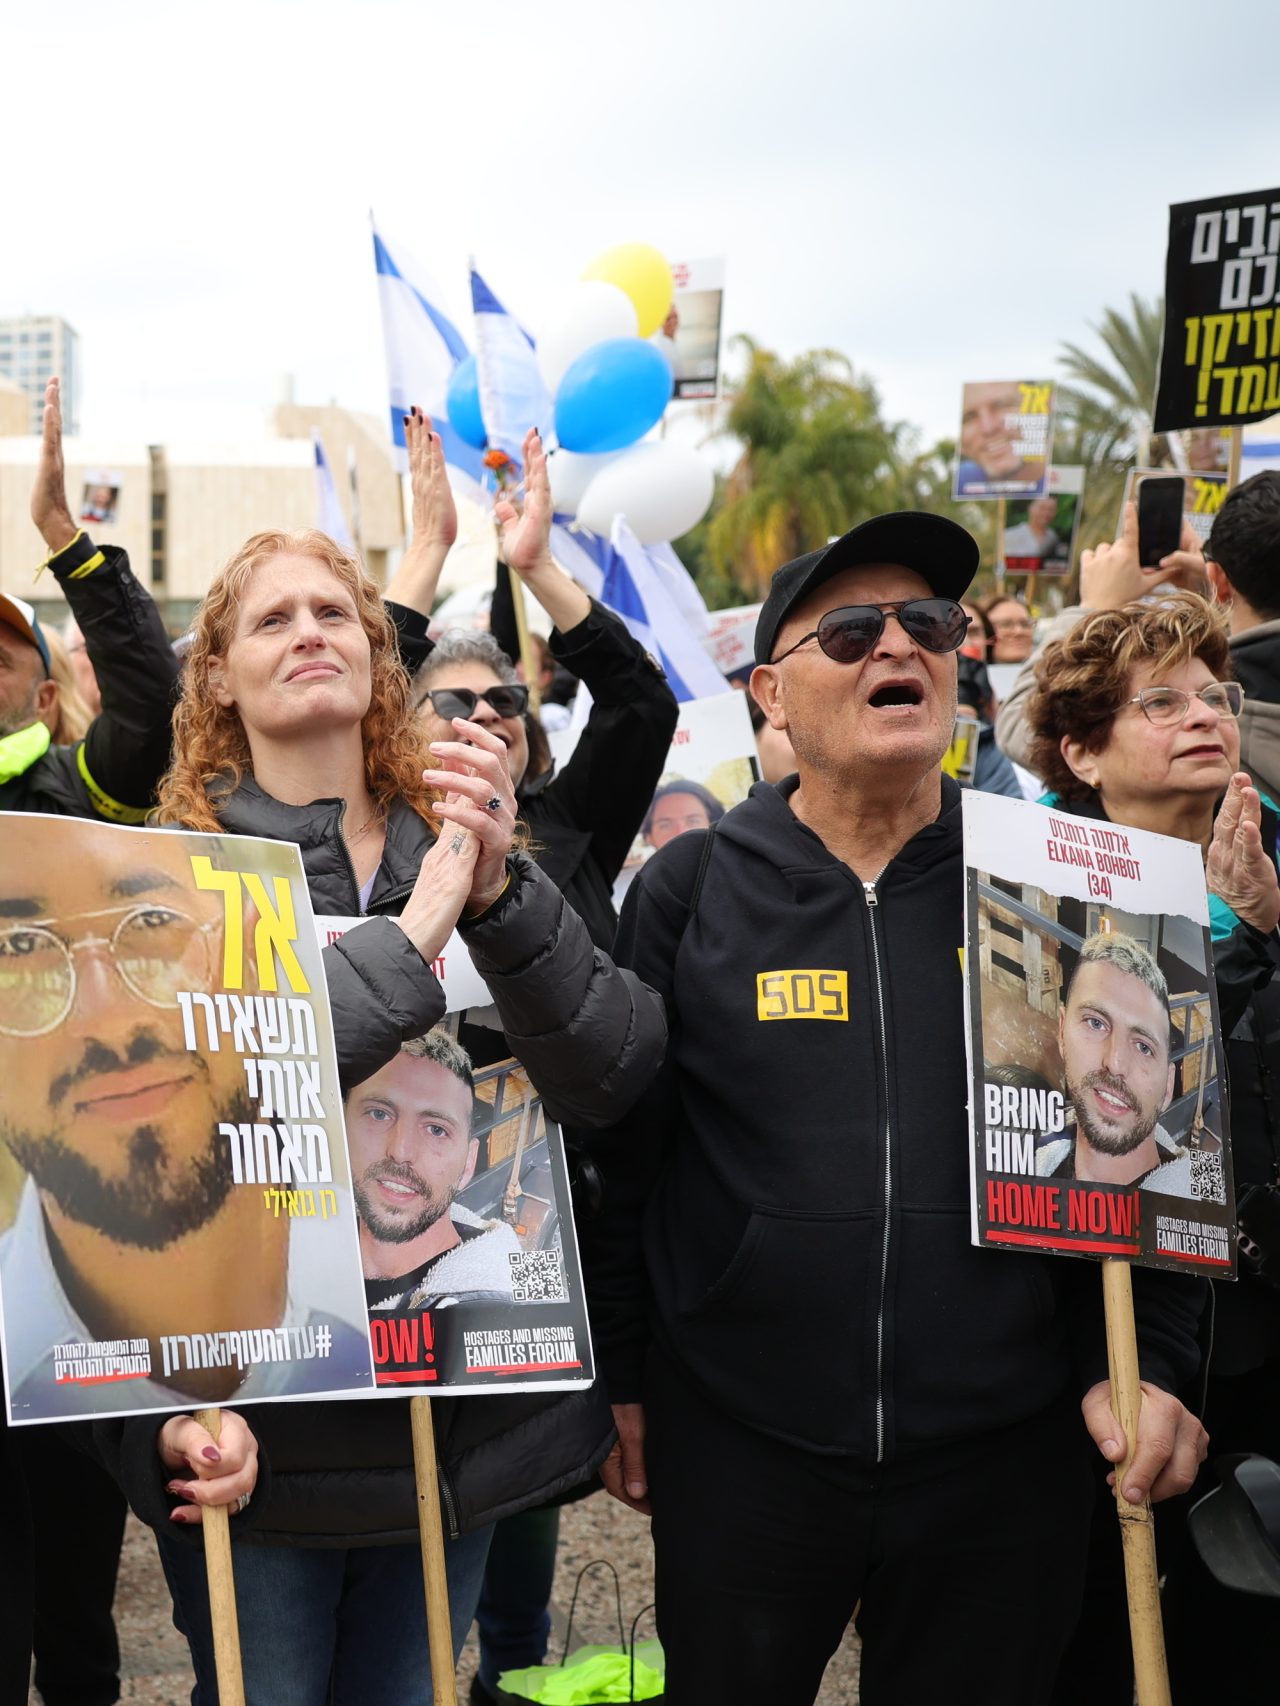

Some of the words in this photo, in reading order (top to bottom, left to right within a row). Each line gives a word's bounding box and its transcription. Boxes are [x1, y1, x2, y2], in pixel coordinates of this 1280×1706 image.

[1219, 254, 1280, 310] כם
[1048, 817, 1090, 846] בוחבוט
[1090, 828, 1131, 856] אלקנה
[1047, 839, 1095, 870] ELKANA
[1095, 852, 1141, 881] BOHBOT
[1088, 871, 1112, 901] (34)
[190, 855, 311, 993] אל
[762, 974, 843, 1016] SOS
[177, 991, 318, 1055] תשאירו
[243, 1058, 326, 1119] אותי
[984, 1083, 1065, 1132] BRING
[219, 1122, 333, 1184] מאחור
[986, 1130, 1035, 1176] HIM
[263, 1187, 317, 1218] גואילי
[320, 1189, 337, 1220] רן
[987, 1180, 1060, 1229] HOME
[1068, 1189, 1141, 1239] NOW!
[1156, 1215, 1188, 1233] HOSTAGES
[1188, 1221, 1201, 1235] AND
[1202, 1224, 1228, 1240] MISSING
[1157, 1230, 1198, 1254] FAMILIES
[1199, 1236, 1230, 1261] FORUM
[53, 1342, 86, 1359] להחזרת
[87, 1339, 129, 1358] המשפחות
[130, 1338, 150, 1354] מטה
[370, 1312, 435, 1364] OW!
[464, 1330, 511, 1346] HOSTAGES
[512, 1328, 532, 1344] AND
[533, 1326, 574, 1343] MISSING
[55, 1357, 104, 1381] והנעדרים
[105, 1354, 151, 1376] החטופים
[465, 1344, 526, 1367] FAMILIES
[530, 1341, 577, 1363] FORUM
